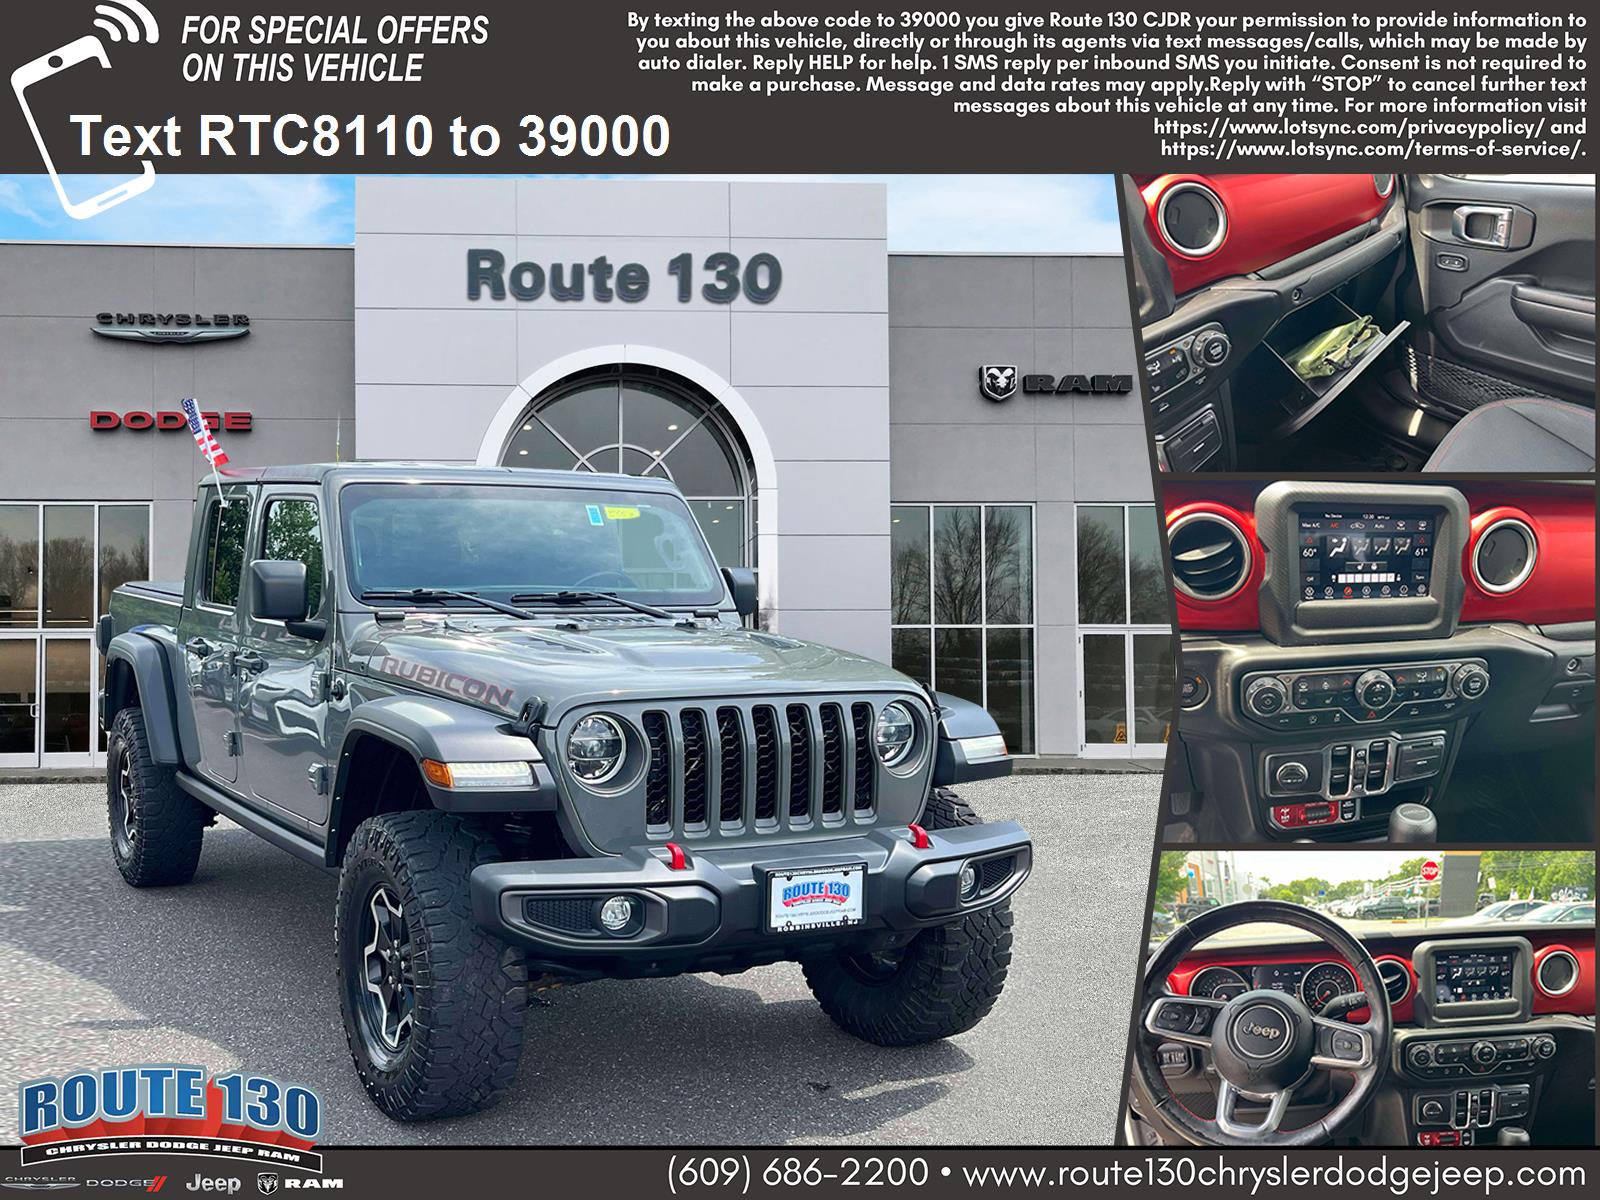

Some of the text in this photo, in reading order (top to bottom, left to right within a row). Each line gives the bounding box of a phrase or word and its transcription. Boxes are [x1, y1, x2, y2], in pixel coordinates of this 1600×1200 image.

[466, 248, 783, 305] Route 130
[96, 312, 250, 326] CHRYSLER
[1023, 374, 1134, 394] RAM
[380, 656, 516, 708] RUBICON
[1422, 866, 1440, 876] STOP
[783, 880, 850, 901] ROUTE 130
[1242, 1021, 1281, 1040] Jeep
